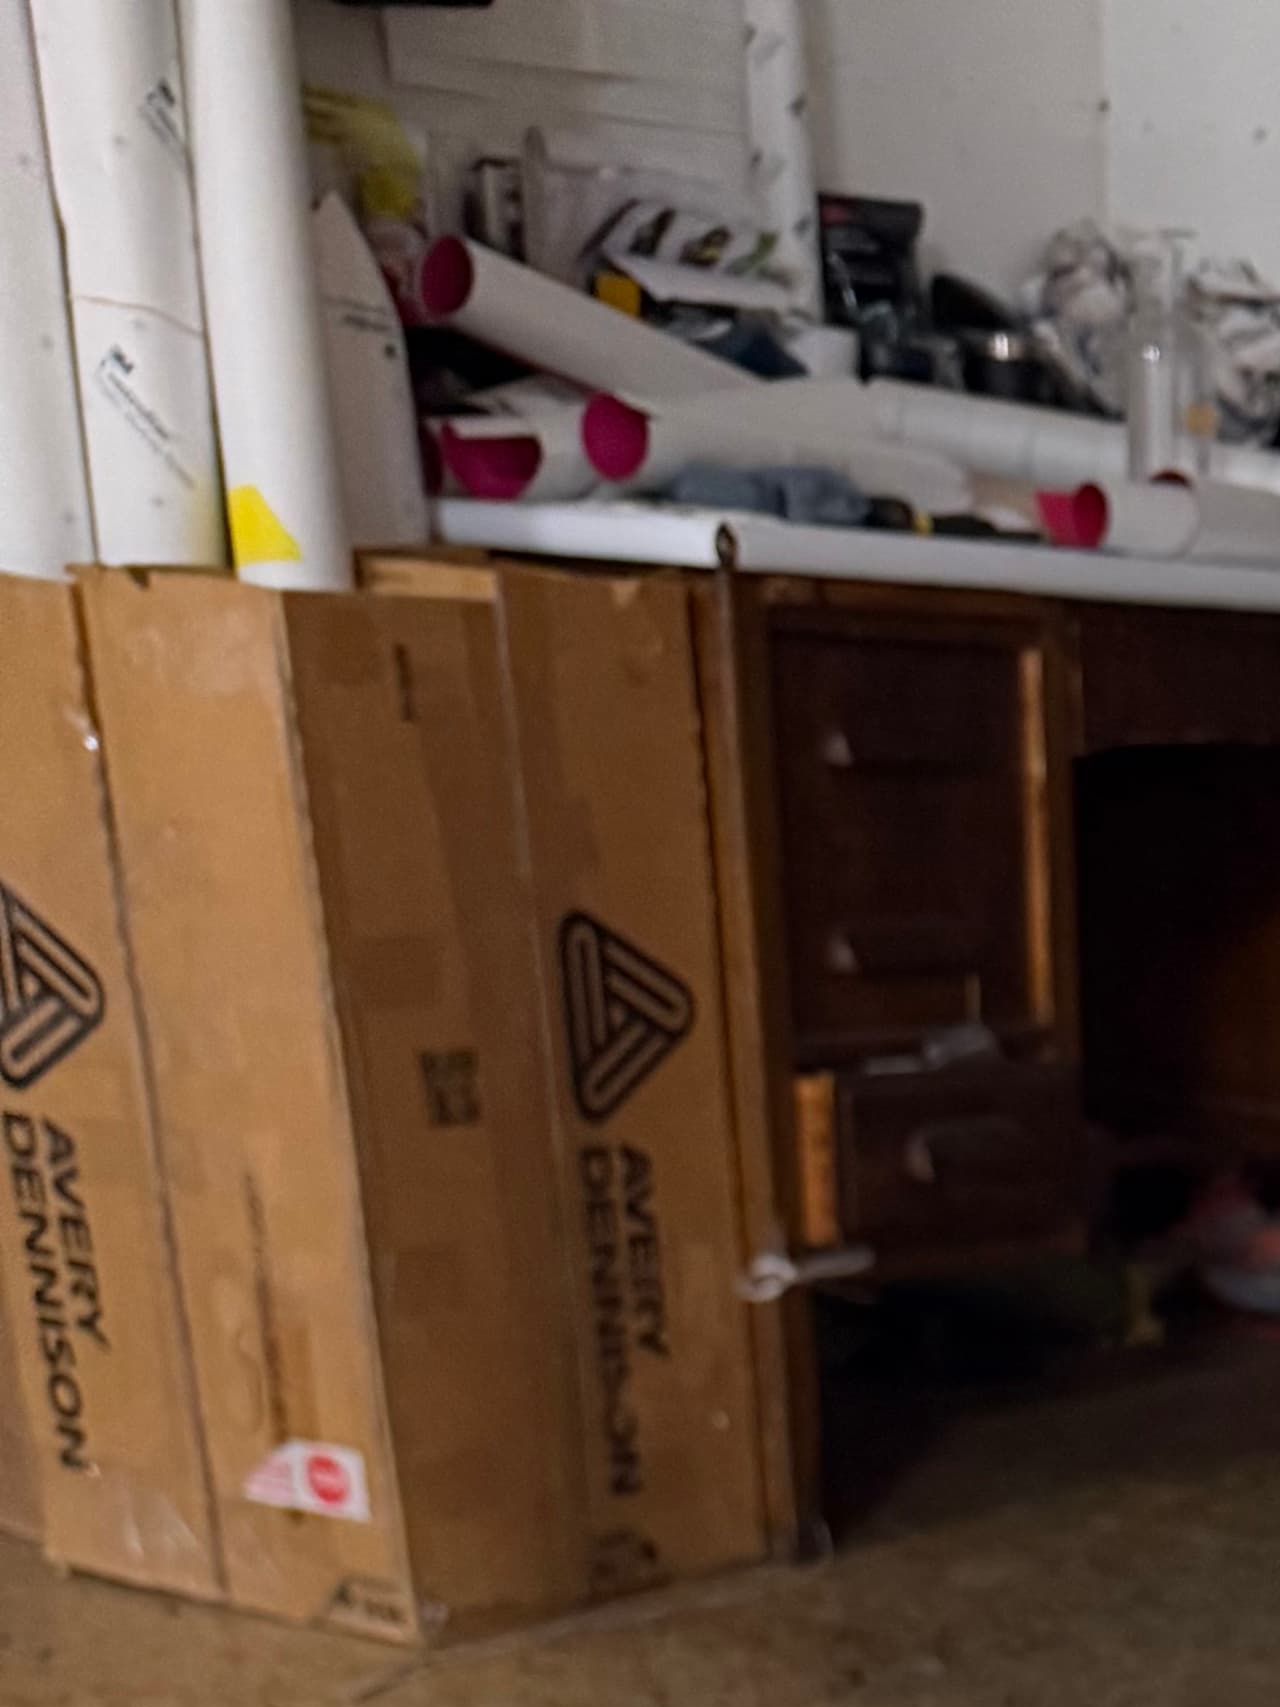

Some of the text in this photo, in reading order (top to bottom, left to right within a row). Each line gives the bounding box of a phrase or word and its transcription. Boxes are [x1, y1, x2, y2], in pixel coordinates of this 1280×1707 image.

[2, 1110, 90, 1471] DENNISON
[42, 1117, 111, 1357] AVERY
[619, 1142, 671, 1358] AVERY
